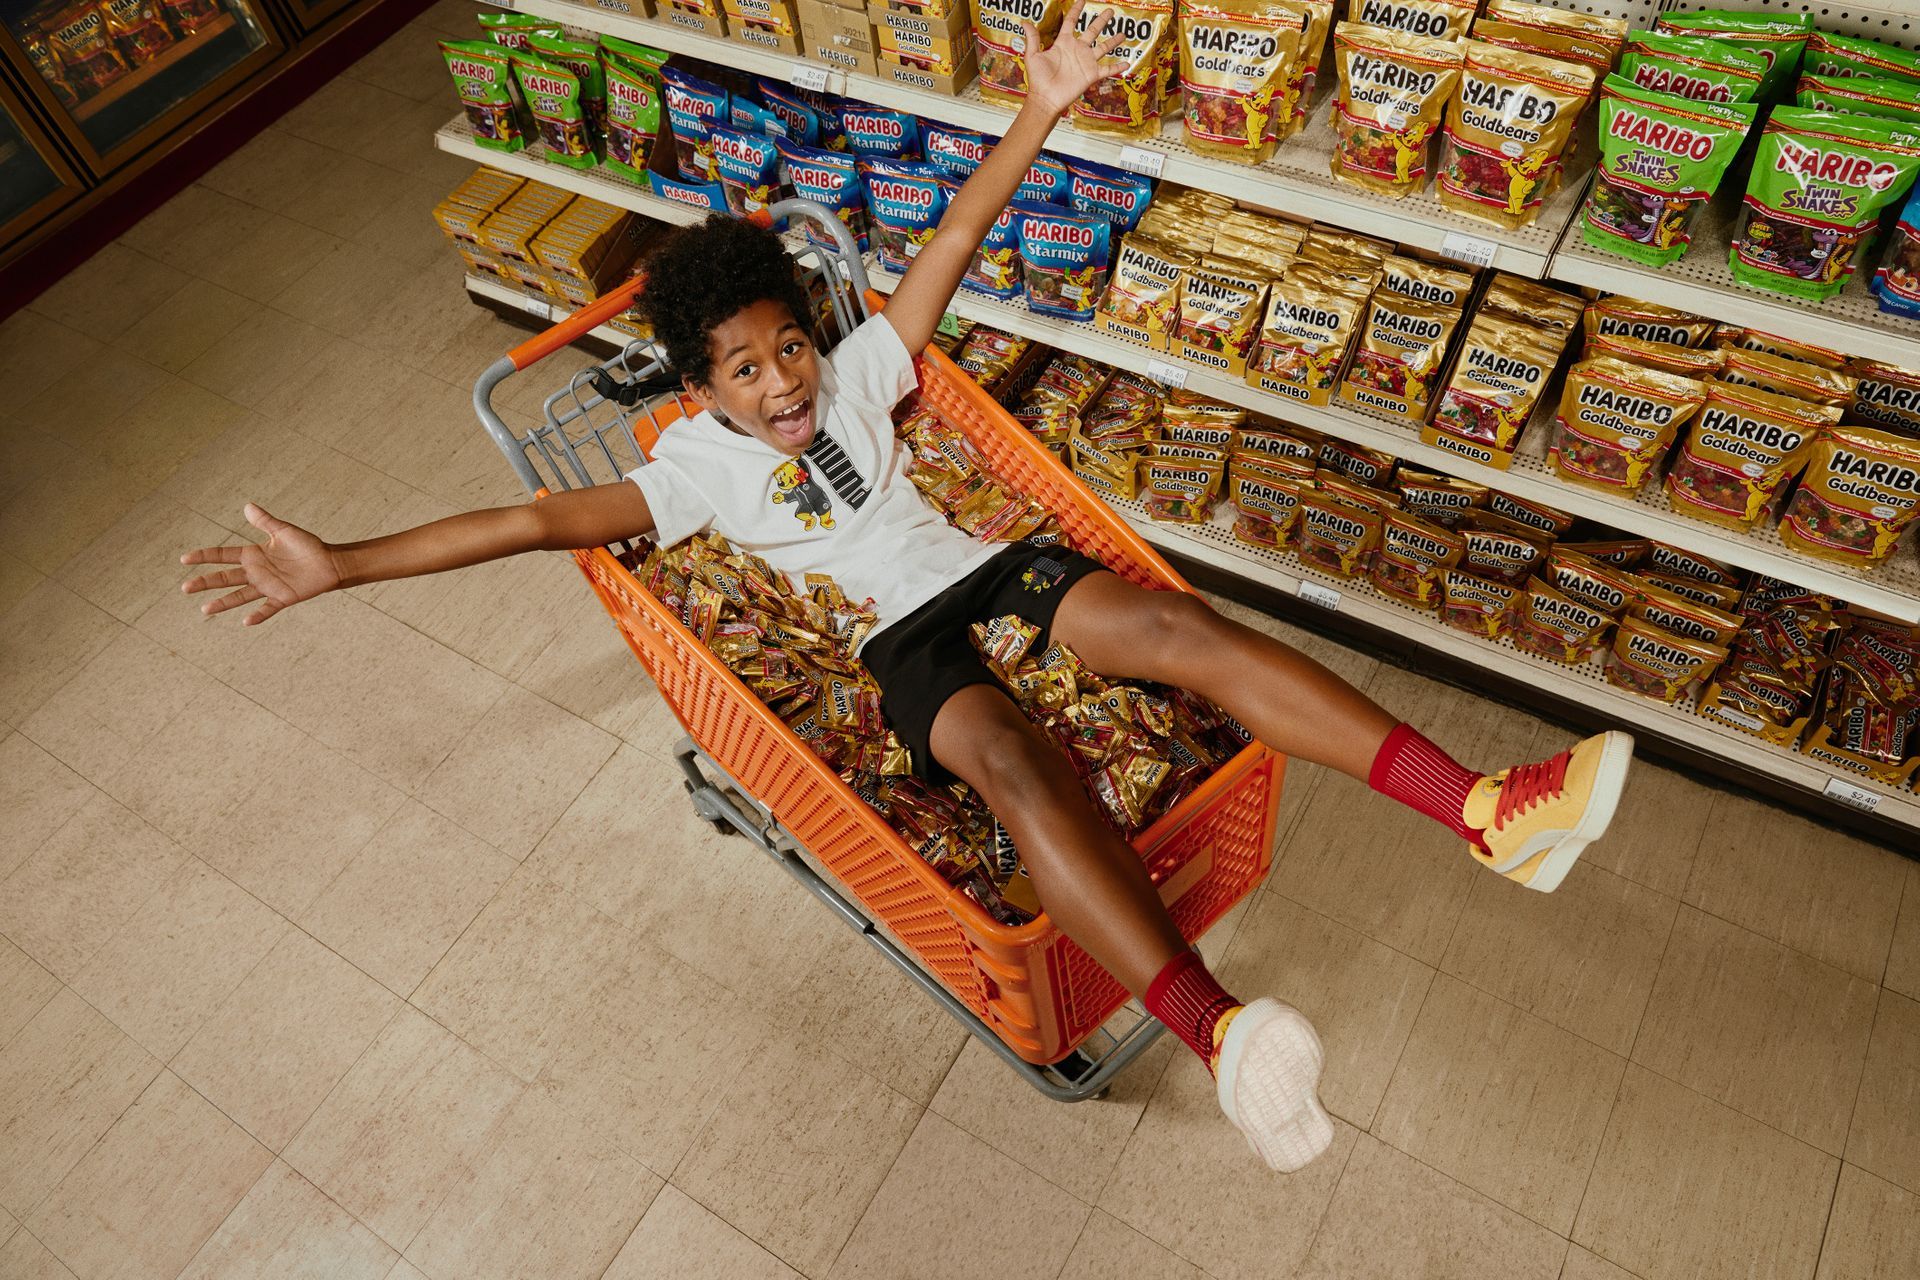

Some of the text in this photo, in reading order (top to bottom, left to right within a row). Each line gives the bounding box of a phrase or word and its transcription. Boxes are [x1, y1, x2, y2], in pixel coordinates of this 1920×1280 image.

[737, 0, 770, 11] HARIBO
[58, 13, 100, 42] HARIBO
[671, 13, 704, 30] HARIBO
[886, 15, 928, 32] HARIBO
[980, 12, 1026, 36] Goldbea
[1075, 12, 1152, 40] HRIBO
[1361, 0, 1448, 37] HARIBO
[499, 34, 529, 48] HAR
[743, 30, 779, 47] HARIBO
[843, 26, 867, 39] 30211
[894, 30, 931, 47] HARIBO
[819, 48, 858, 66] HARIBO
[1571, 45, 1594, 57] Party
[451, 60, 495, 82] HARIBO
[894, 69, 934, 88] HARIBO
[1350, 55, 1437, 95] HARIBO
[523, 72, 571, 98] HARIBO
[534, 99, 564, 113] SNAKES
[539, 96, 555, 104] TWIN
[1463, 79, 1557, 126] HARBO
[1708, 103, 1732, 119] Party
[670, 112, 708, 134] Starmix
[844, 114, 903, 138] HARIBO
[1462, 110, 1540, 143] Goldbears
[850, 136, 899, 151] Starmix
[929, 131, 985, 162] HARIBO
[1610, 109, 1716, 163] HARIBO
[1889, 132, 1917, 144] Party
[712, 133, 763, 166] HARIBO
[1633, 150, 1665, 166] TWIN
[716, 156, 759, 179] Starmix
[930, 153, 976, 176] Starmi
[1613, 154, 1681, 186] SNAKES
[1776, 143, 1899, 193] HARIBO
[663, 185, 710, 207] HARIBO
[797, 186, 837, 204] tarmix
[871, 178, 933, 207] HARIBO
[1074, 177, 1136, 209] HARIBO
[1781, 189, 1859, 218] SNAKES
[1804, 184, 1841, 199] TWIN
[874, 200, 925, 222] Starmix
[1074, 197, 1127, 225] Starmix
[1024, 219, 1093, 247] HARIBO
[1027, 243, 1084, 262] Starmix
[1122, 247, 1180, 280] HARIBO
[1121, 267, 1168, 292] Goldbears
[1188, 278, 1249, 306] HARIBO
[1387, 274, 1455, 304] HARIBO
[1275, 301, 1340, 330] HARIBO
[1373, 308, 1442, 339] HARIBO
[1108, 321, 1150, 342] HARIBO
[1275, 322, 1329, 344] Goldbears
[1372, 330, 1430, 351] Goldbears
[958, 360, 981, 372] RIBO
[1050, 360, 1083, 381] HARIBO
[1184, 347, 1229, 369] HARIBO
[1468, 348, 1540, 384] HARIBO
[1120, 375, 1157, 395] HARIBO
[1164, 367, 1184, 380] $5.49
[1467, 370, 1526, 397] Goldbears
[1261, 379, 1310, 400] HARIBO
[1857, 380, 1920, 415] HARI
[1357, 392, 1408, 414] HARIBO
[1579, 385, 1674, 425] HARIBO
[1795, 409, 1816, 420] Party
[1173, 427, 1230, 444] HARIBO
[1579, 409, 1656, 441] Goldbears
[1702, 410, 1802, 452] HARIBO
[938, 440, 968, 472] HARIBO
[1072, 439, 1109, 465] HARIBO
[1244, 436, 1311, 459] HARIBO
[1437, 436, 1492, 462] HARIBO
[1701, 434, 1781, 466] Goldbears
[1320, 445, 1376, 481] HARIBO
[1074, 469, 1112, 489] HARIBO
[1150, 468, 1209, 484] HARIBO
[1153, 481, 1204, 495] Goldbears
[1240, 480, 1298, 508] HARIBO
[1407, 488, 1472, 509] HARIBO
[1828, 478, 1915, 510] Goldbears
[1242, 497, 1291, 519] Goldbears
[1493, 496, 1555, 532] HARIBO
[1305, 506, 1365, 539] HARIBO
[1307, 525, 1356, 548] Goldbears
[1385, 526, 1449, 559] HARIBO
[1468, 536, 1537, 562] HARIBO
[1386, 543, 1438, 568] Goldbears
[1469, 554, 1527, 572] Goldbears
[1654, 548, 1723, 584] HARIBO
[1449, 588, 1504, 610] Goldbears
[1557, 571, 1624, 607] HARIBO
[1532, 612, 1588, 638] Goldbears
[1533, 595, 1601, 630] HARIBO
[1645, 607, 1717, 642] HARIBO
[1629, 652, 1690, 675] Goldbears
[1720, 689, 1759, 710] oldbears
[1750, 683, 1797, 713] HARIBO
[1847, 707, 1865, 753] HARIBO
[1893, 716, 1904, 756] Goldbears
[1170, 740, 1198, 766] HARIBO
[1811, 748, 1870, 773] HARIBO
[1850, 791, 1877, 806] $2.49
[920, 833, 942, 858] RIBO
